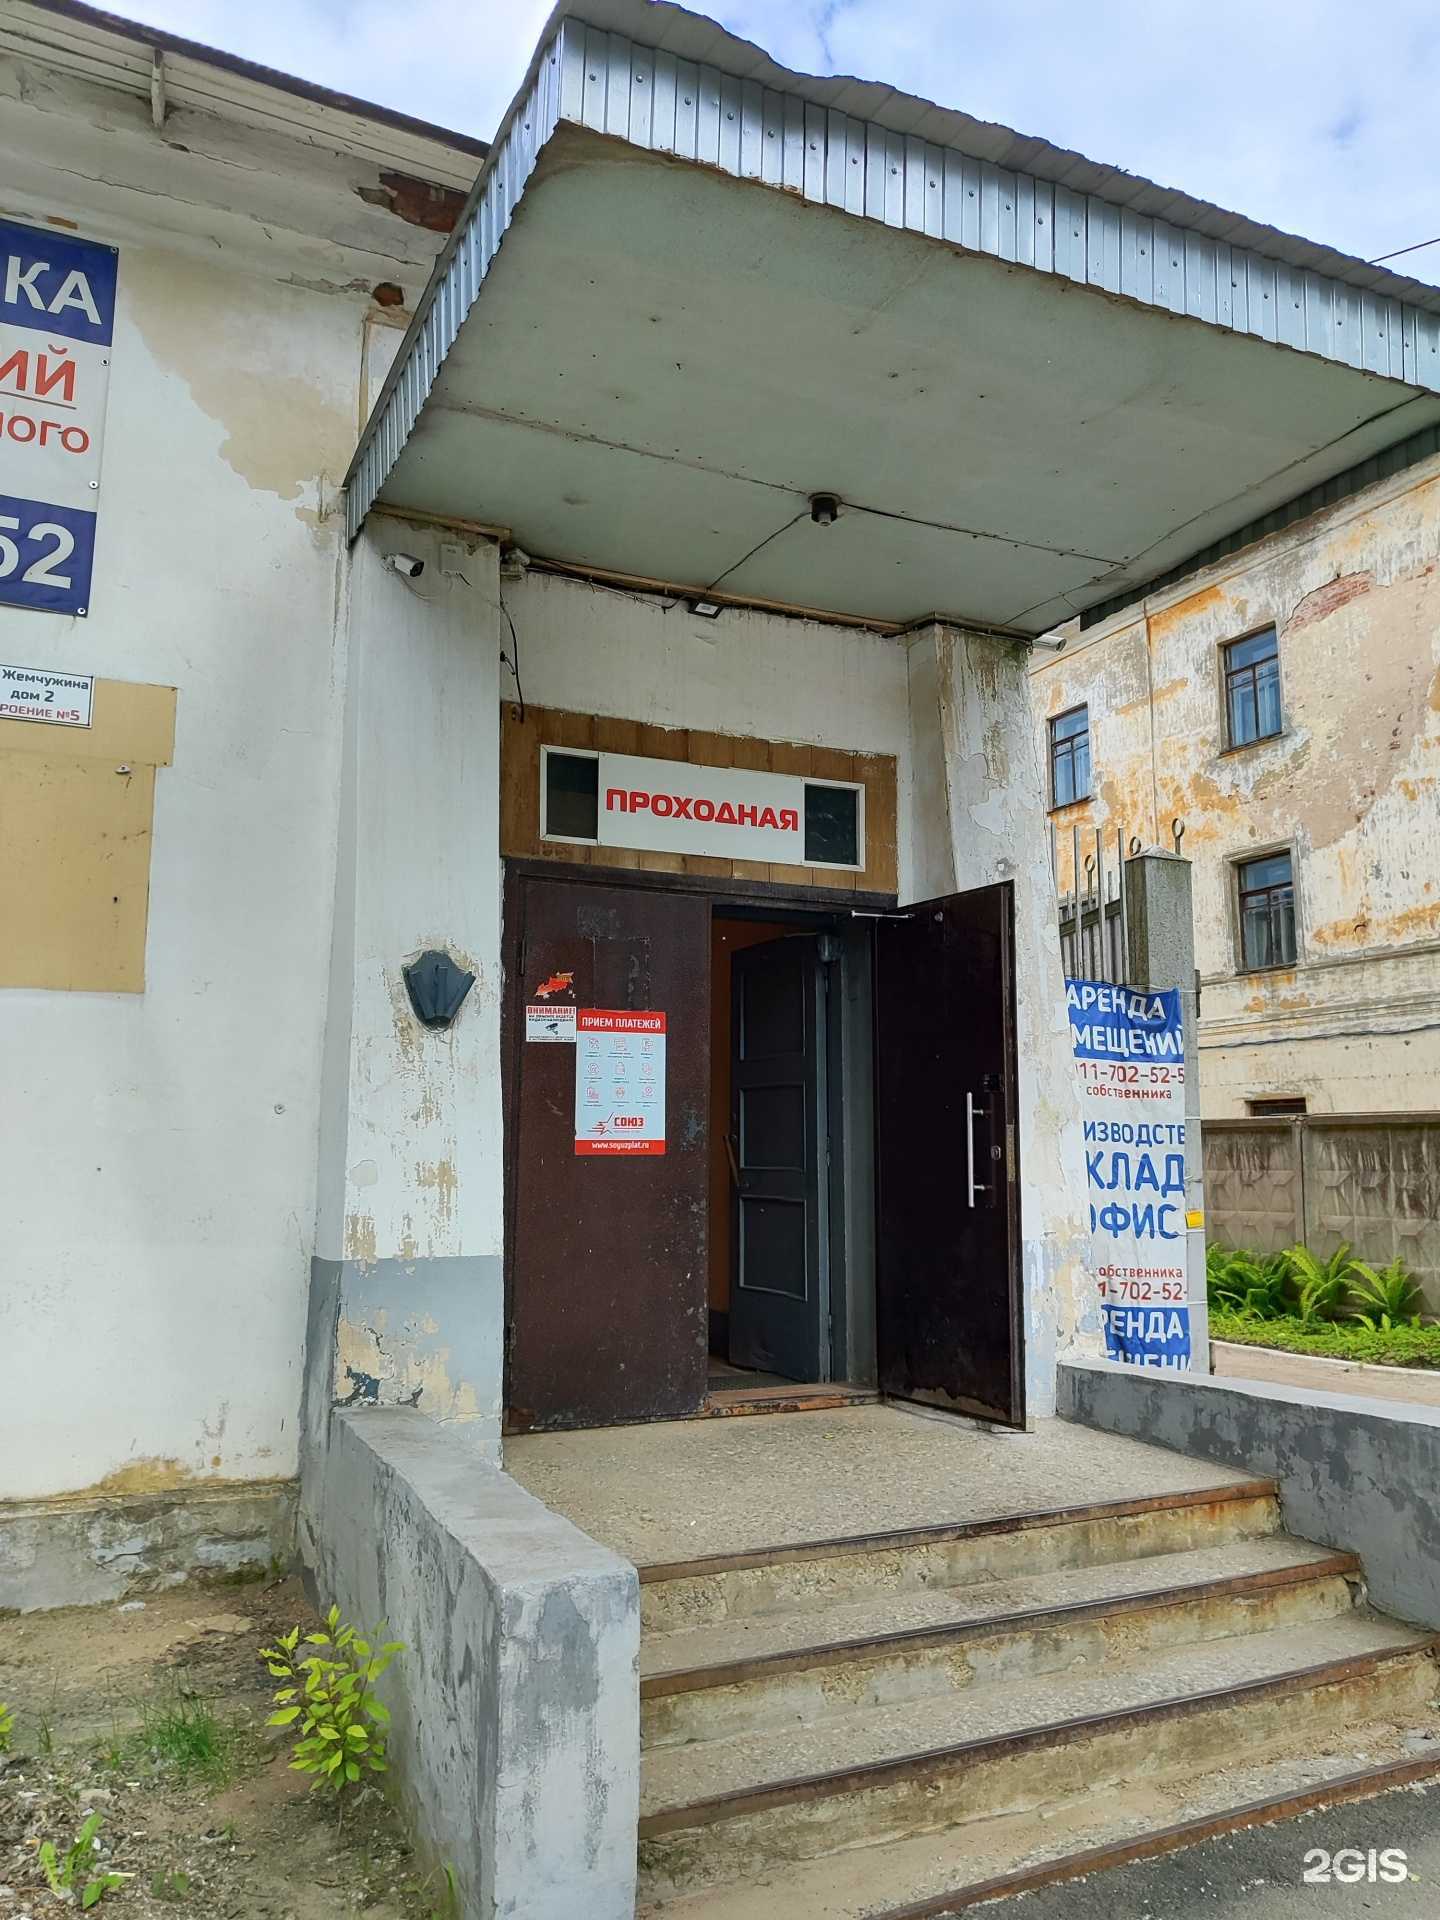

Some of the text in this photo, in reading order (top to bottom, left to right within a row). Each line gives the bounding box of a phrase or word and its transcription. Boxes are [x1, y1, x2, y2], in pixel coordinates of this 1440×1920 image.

[4, 255, 102, 325] КА
[2, 669, 89, 689] Жемчужина
[10, 690, 55, 702] дом 2
[56, 710, 80, 721] №5
[606, 788, 798, 831] ПРОХОДНАЯ
[1065, 983, 1167, 1021] АРЕНДА
[582, 1017, 661, 1029] ПРИЕМ ПЛАТЕЖЕЙ
[1075, 1062, 1184, 1084] 11-702-52-5
[1086, 1084, 1172, 1099] собственника
[614, 1117, 644, 1127] СОЮЗ
[591, 1141, 650, 1150] www.soyuzplat.ru
[1089, 1202, 1179, 1239] ФИС
[1096, 1264, 1183, 1278] обственника
